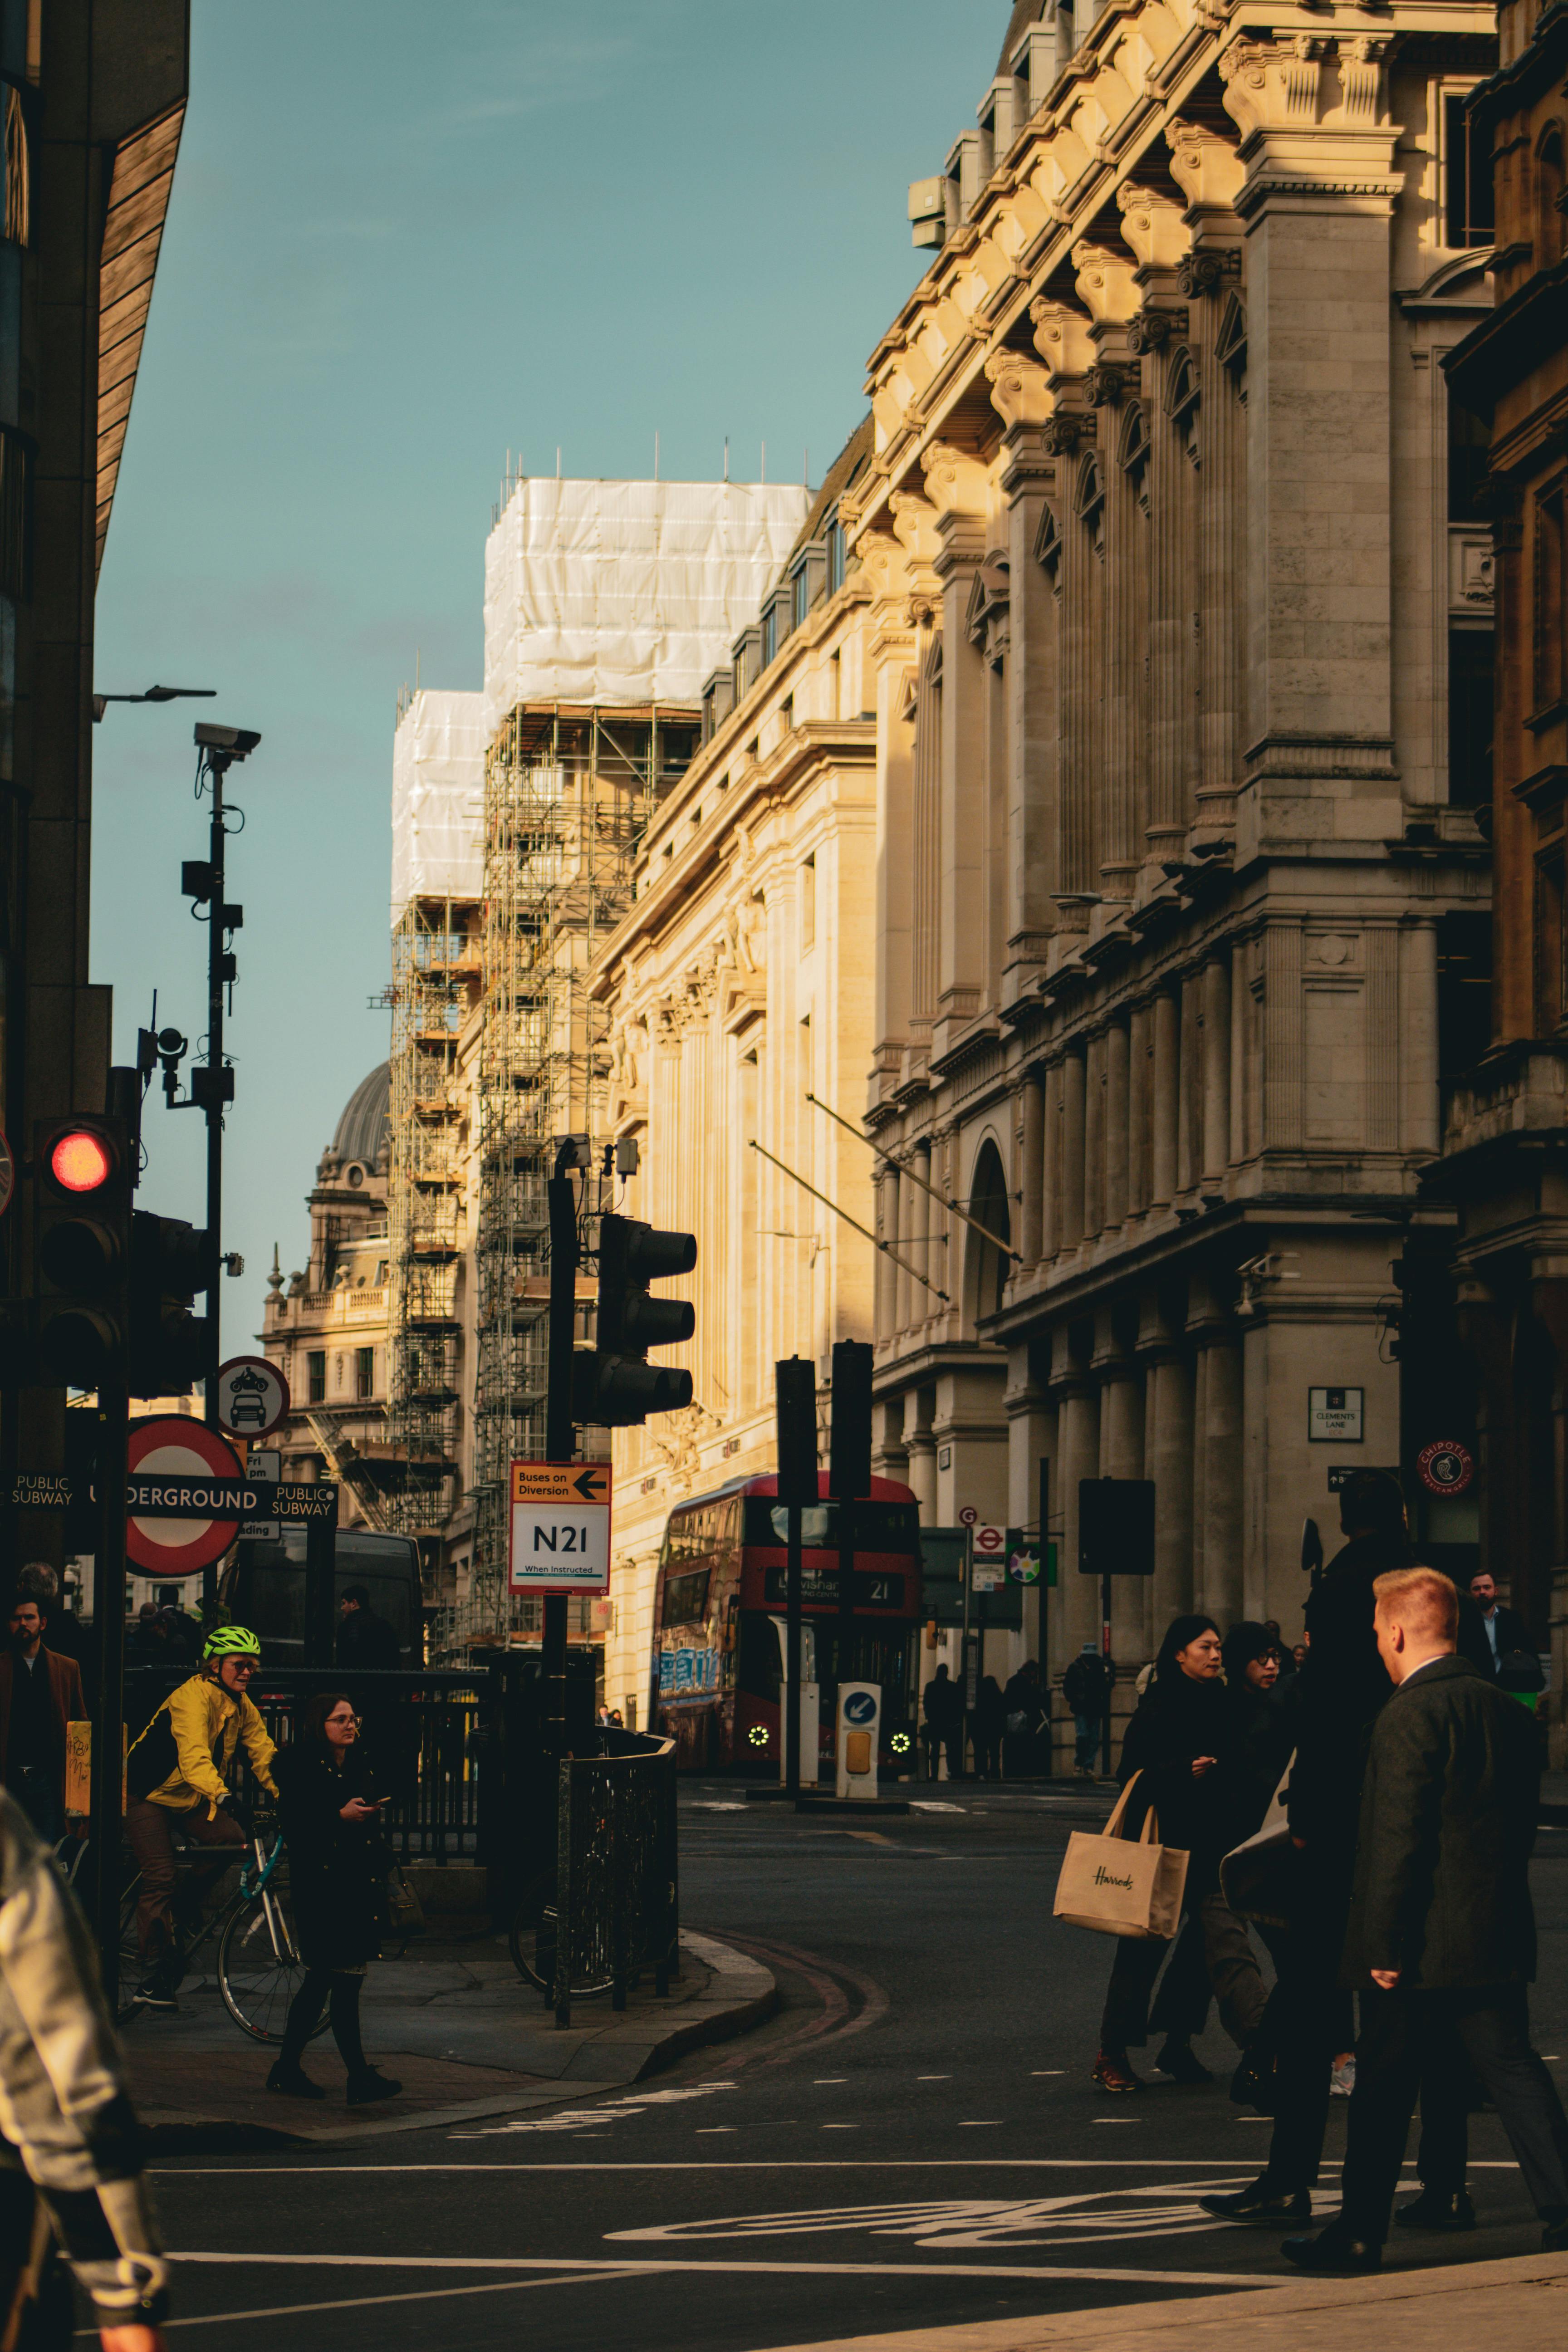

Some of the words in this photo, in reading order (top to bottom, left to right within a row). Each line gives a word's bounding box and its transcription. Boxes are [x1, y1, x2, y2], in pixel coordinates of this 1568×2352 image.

[1421, 1442, 1470, 1464] CHIPOTLE
[247, 1457, 261, 1465] Fri
[17, 1475, 69, 1490] PUBLIC
[519, 1472, 550, 1482] Buses
[1423, 1474, 1452, 1493] MEXICAN
[1453, 1474, 1470, 1491] GRILL
[12, 1490, 73, 1505] SUBWAY
[90, 1485, 257, 1509] DERGROUND
[277, 1487, 327, 1501] PUBLIC
[519, 1485, 568, 1495] Diversion
[272, 1501, 331, 1516] SUBWAY
[962, 1509, 974, 1523] G
[240, 1526, 269, 1536] ading
[534, 1526, 586, 1552] N21
[779, 1576, 839, 1590] Lisha
[870, 1580, 888, 1599] 21
[1092, 1866, 1133, 1890] Harrods
